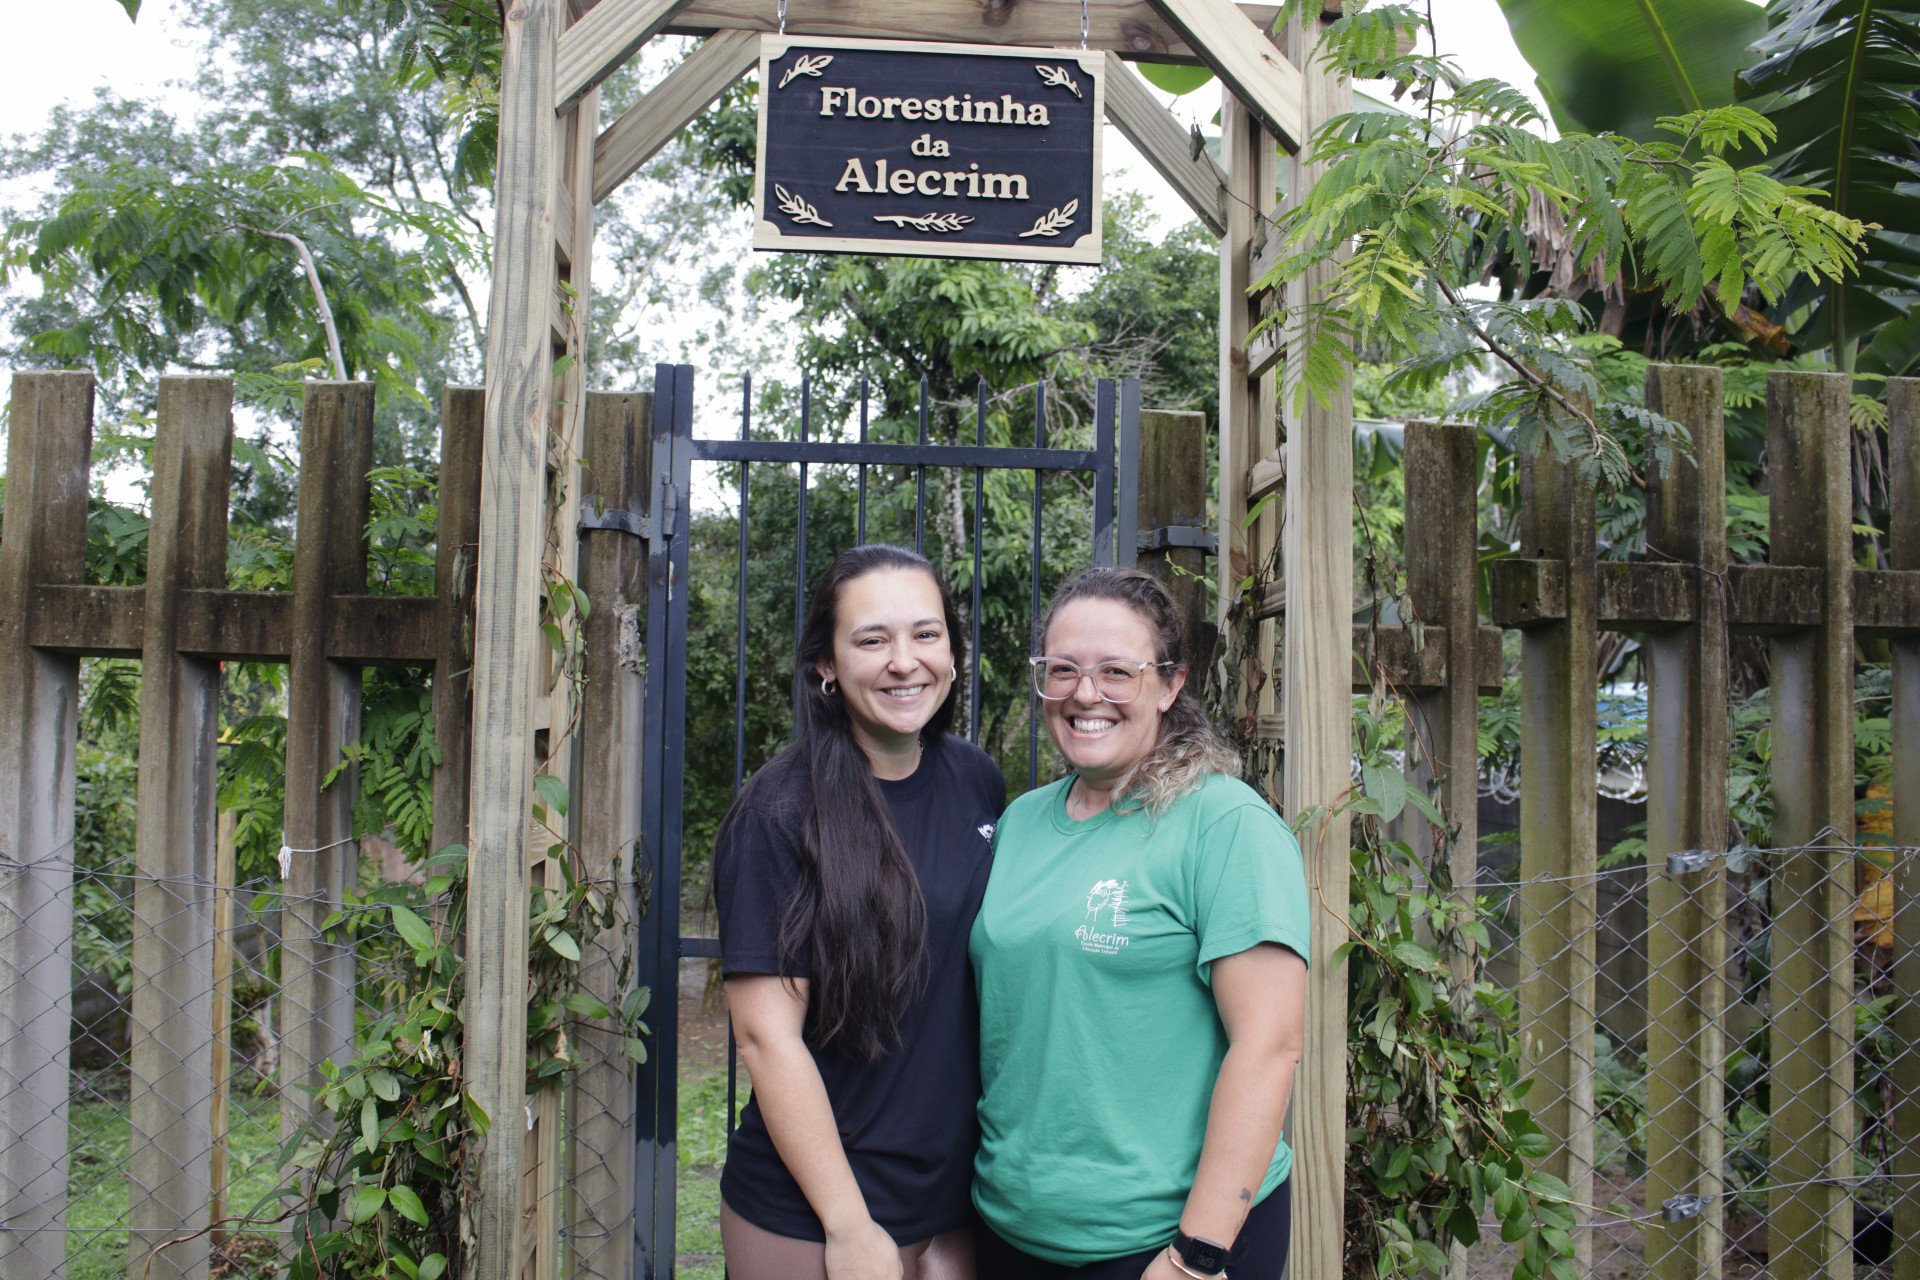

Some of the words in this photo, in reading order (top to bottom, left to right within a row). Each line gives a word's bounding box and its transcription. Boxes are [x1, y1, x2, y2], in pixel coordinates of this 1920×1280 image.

[819, 86, 1050, 126] Florestinha
[910, 133, 951, 157] da
[835, 157, 1030, 200] Alecrim
[1074, 924, 1129, 946] Alecrim
